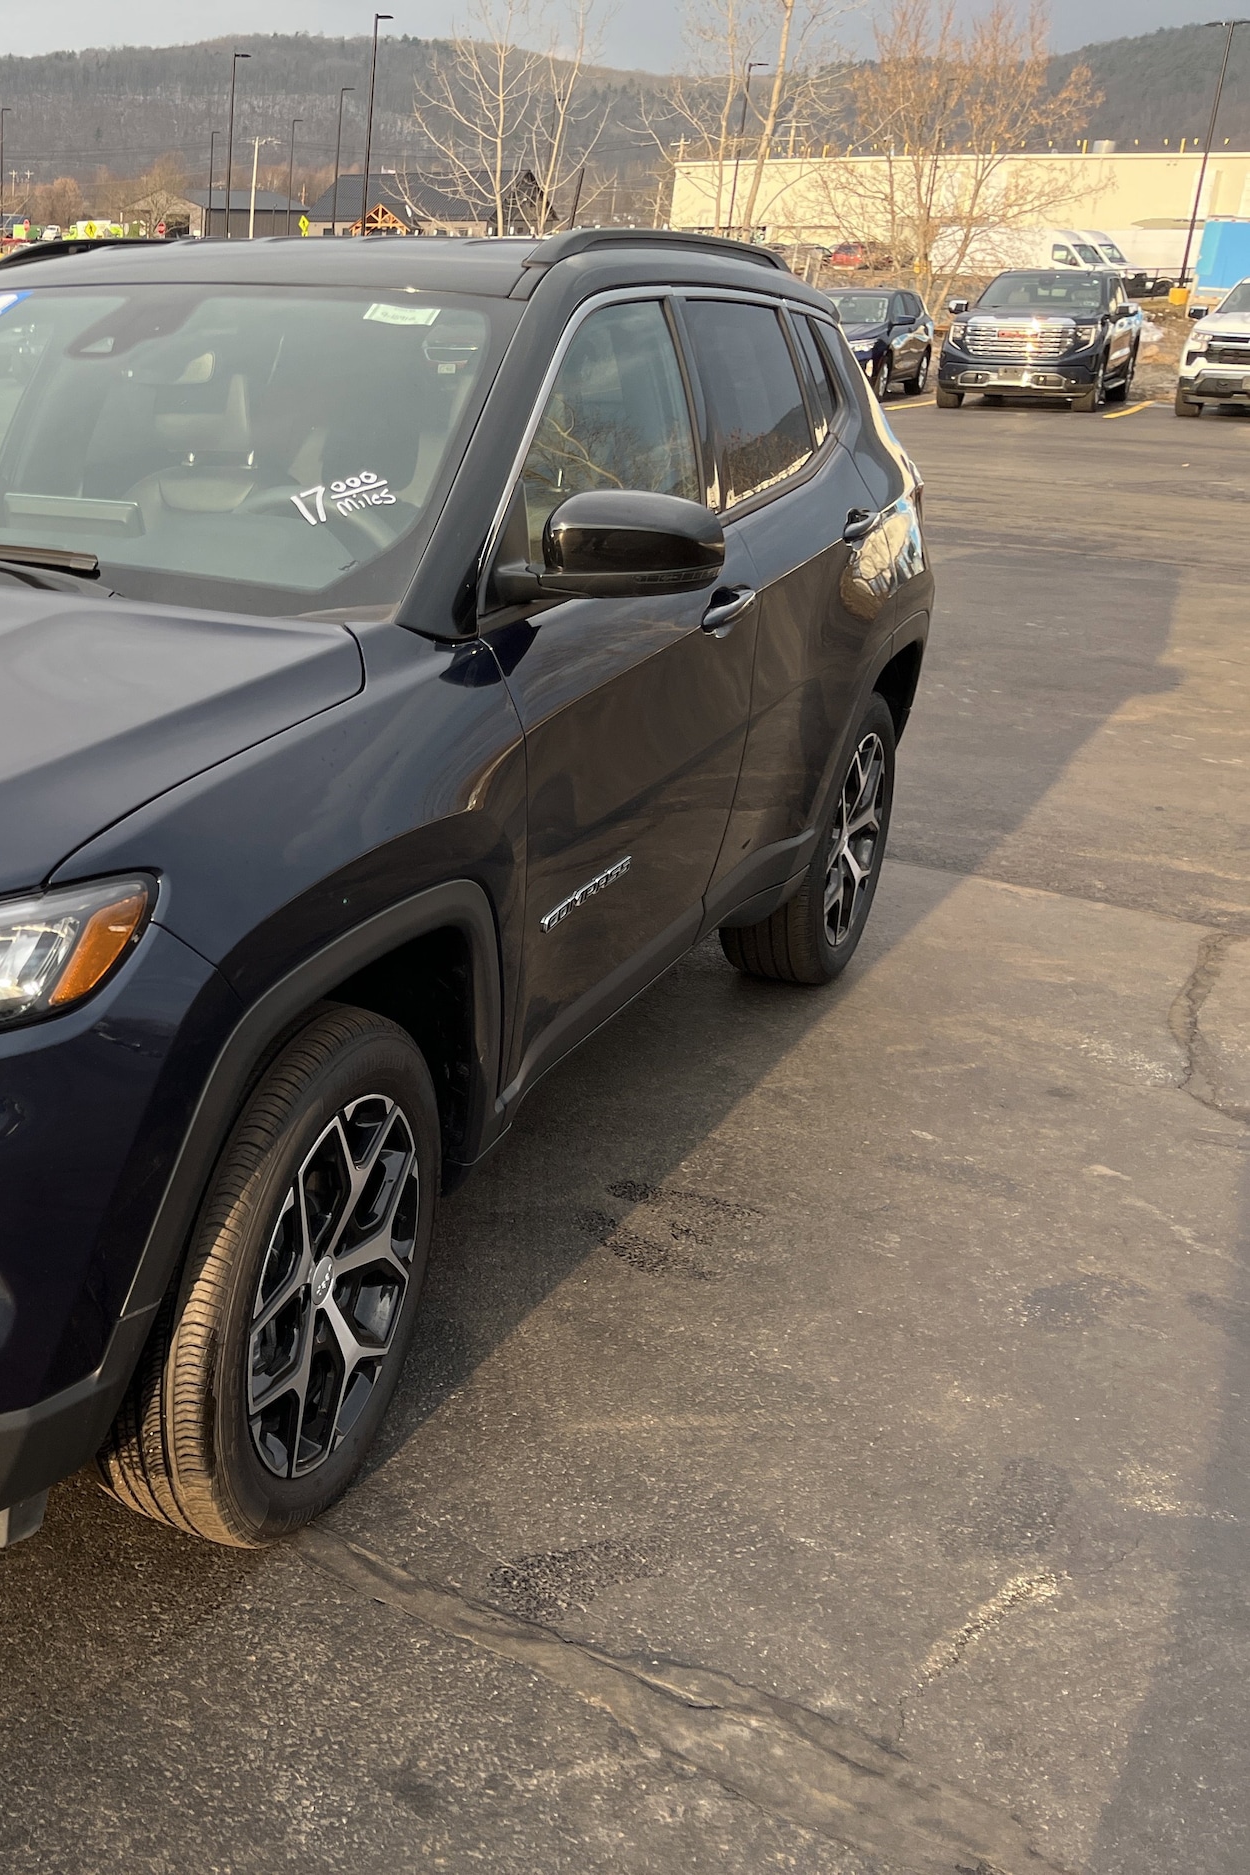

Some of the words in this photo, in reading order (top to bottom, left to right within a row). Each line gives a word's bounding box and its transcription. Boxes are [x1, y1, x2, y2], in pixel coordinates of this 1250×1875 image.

[290, 485, 327, 526] 17
[330, 470, 378, 493] 000
[539, 854, 633, 935] COMPASS
